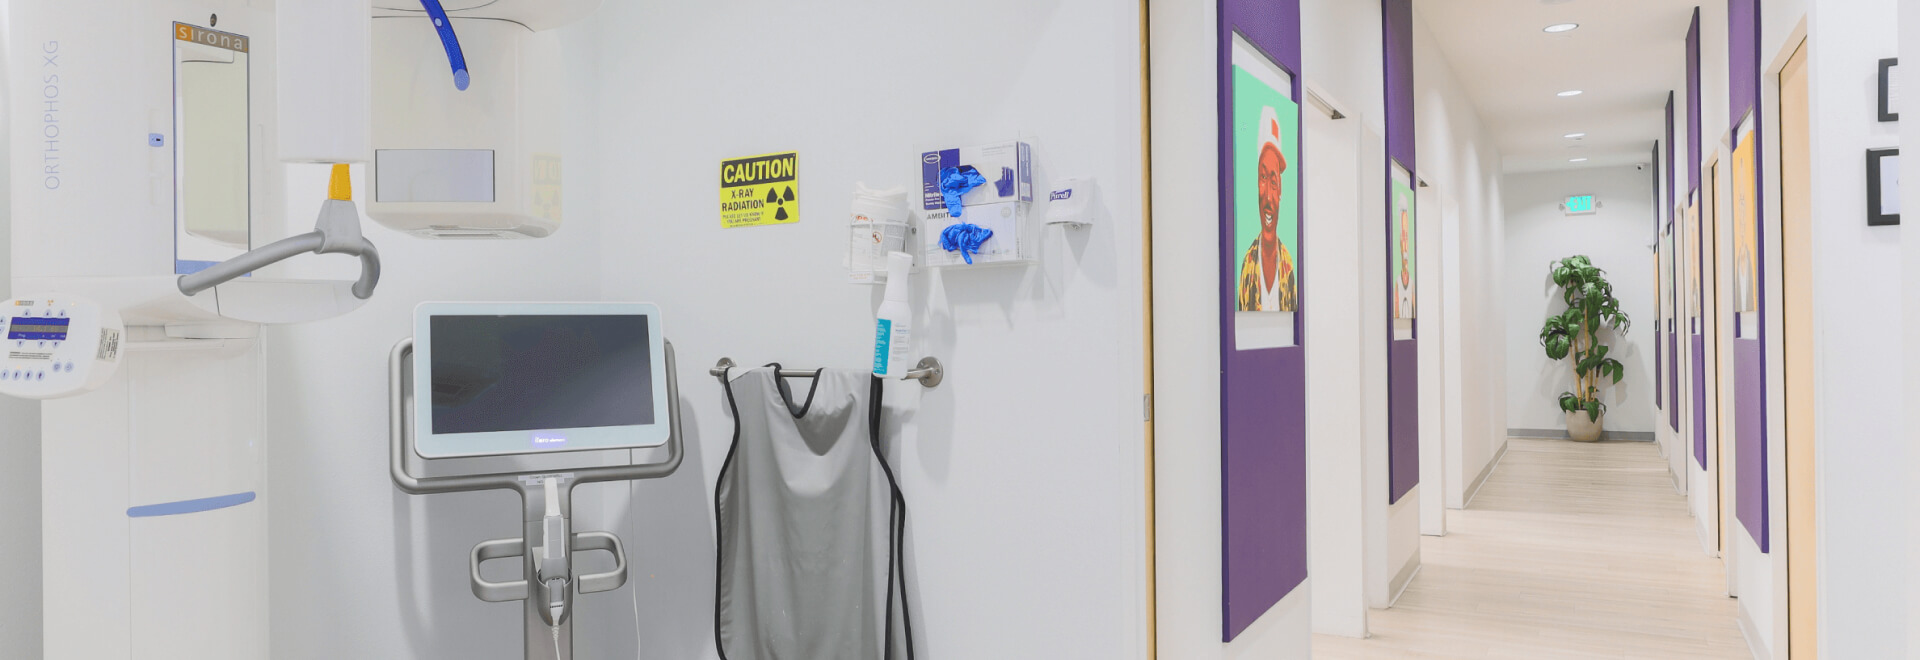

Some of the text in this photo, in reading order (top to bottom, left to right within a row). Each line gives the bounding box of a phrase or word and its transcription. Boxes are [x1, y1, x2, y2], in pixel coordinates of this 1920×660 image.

[178, 25, 243, 50] sirona
[43, 40, 60, 190] ORTHOPHOS XG
[723, 157, 794, 184] CAUTION
[731, 188, 754, 199] X-RAY
[722, 199, 765, 212] RADIATION
[1570, 195, 1592, 212] EXIT
[926, 211, 953, 220] AMBIT
